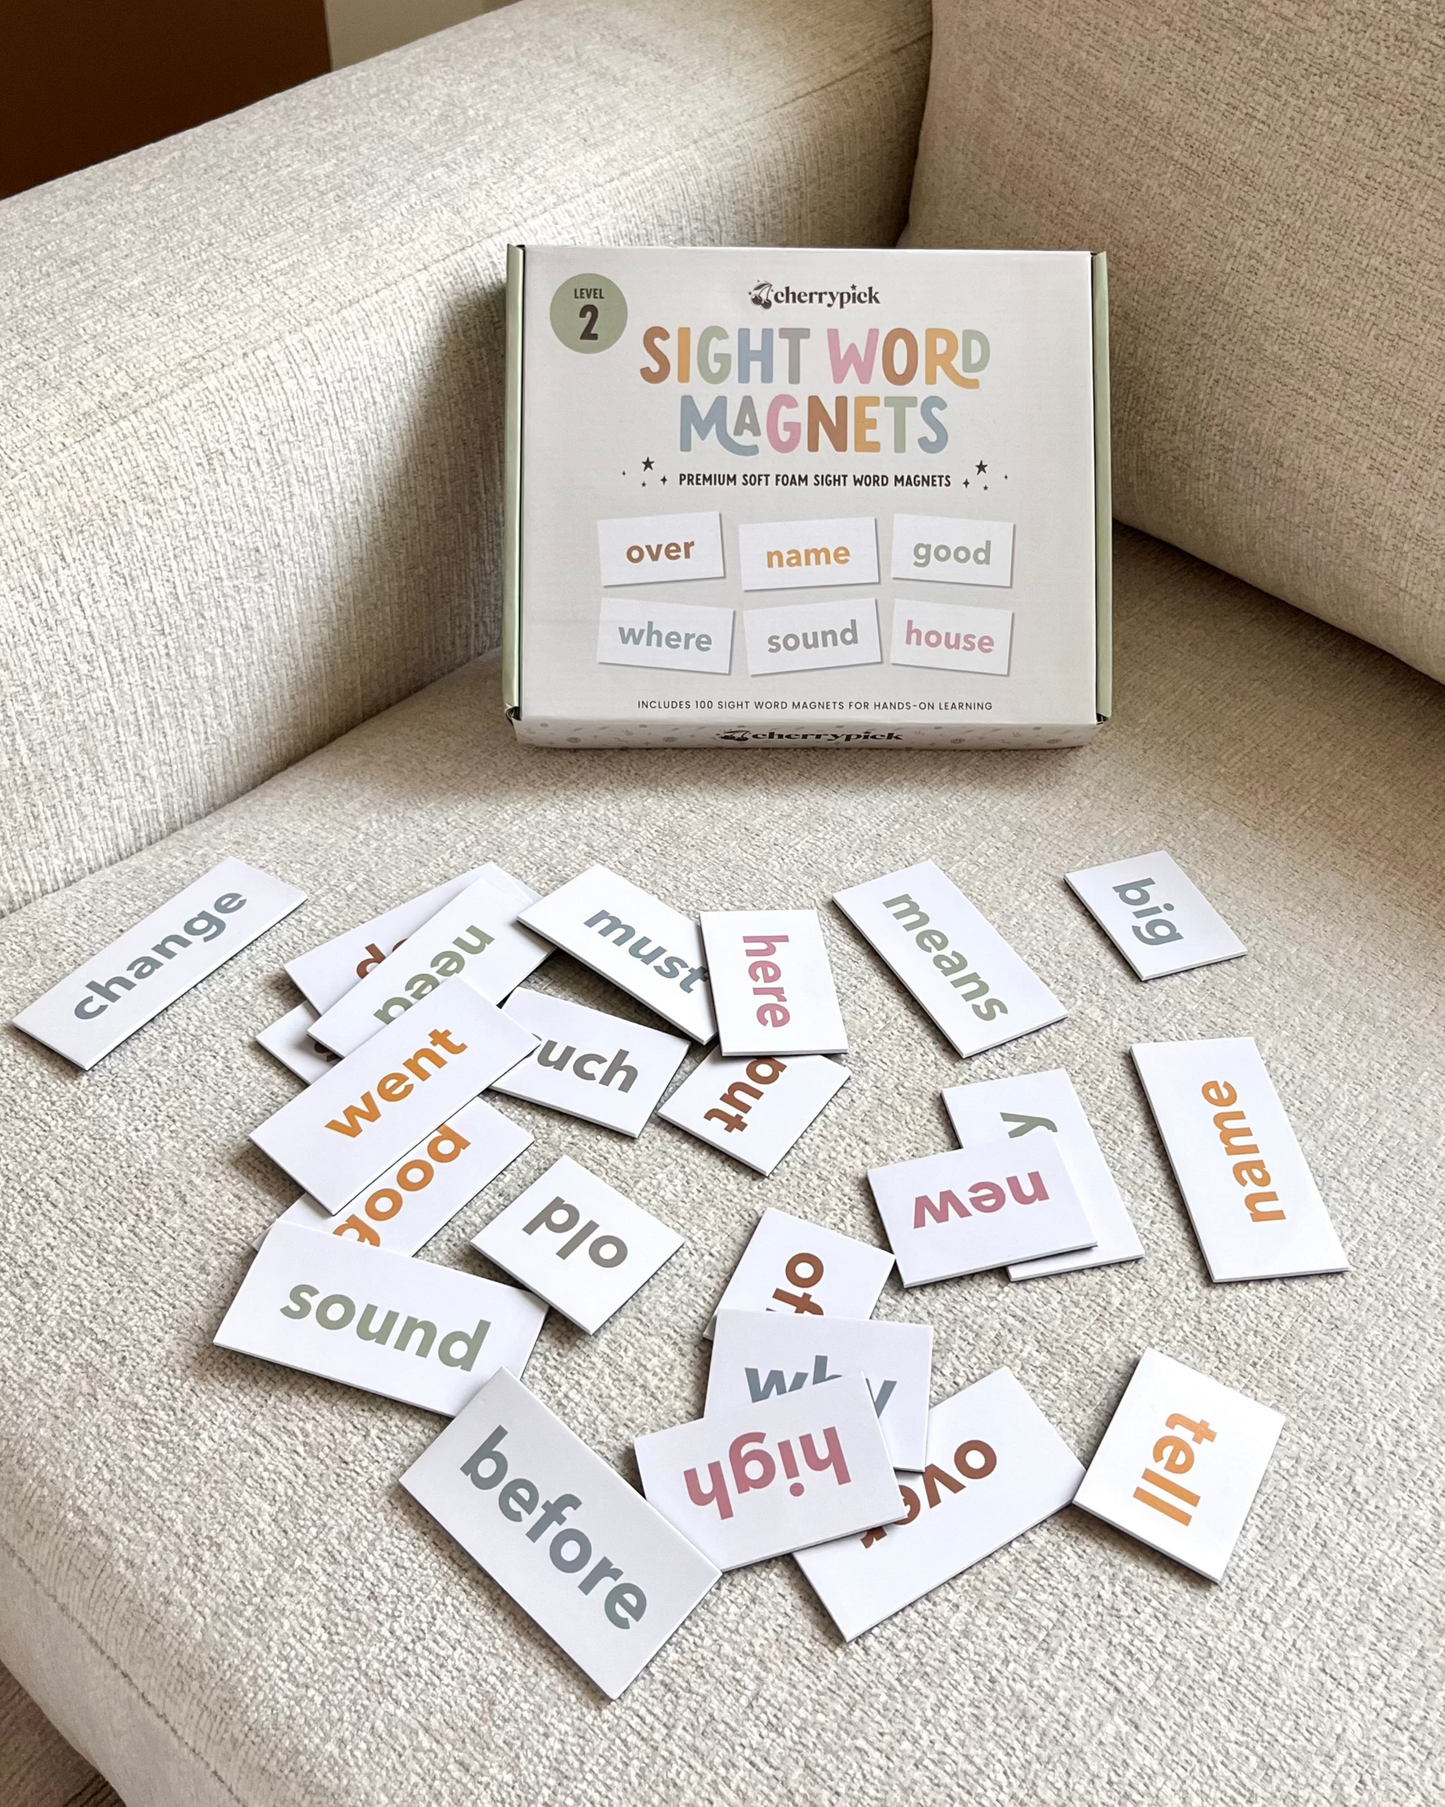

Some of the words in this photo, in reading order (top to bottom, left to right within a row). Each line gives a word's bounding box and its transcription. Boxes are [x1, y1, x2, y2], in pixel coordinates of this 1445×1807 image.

[574, 288, 604, 300] LEVEL
[579, 304, 599, 341] 2
[774, 284, 881, 309] cherrypick
[640, 326, 811, 385] SIGHT
[826, 328, 991, 390] WORD
[680, 394, 949, 457] MAGNETS
[679, 473, 737, 487] PREMIUM
[741, 473, 771, 487] SOFT
[775, 473, 809, 487] FOAM
[813, 474, 848, 488] SIGHT
[852, 474, 889, 488] WORD
[894, 475, 952, 489] MAGNETS
[625, 540, 695, 564] over
[766, 545, 851, 569] name
[913, 540, 992, 568] good
[618, 621, 713, 652] where
[767, 619, 859, 654] sound
[905, 620, 995, 654] house
[637, 700, 691, 710] INCLUDES
[694, 700, 713, 710] 100
[717, 700, 750, 710] SIGHT
[753, 700, 788, 710] WORD
[791, 701, 845, 711] MAGNETS
[848, 701, 870, 711] FOR
[873, 701, 935, 711] HANDS-ON
[938, 701, 993, 711] LEARNING
[752, 731, 903, 743] cherrypick
[1112, 878, 1184, 946] big
[74, 893, 246, 1019] change
[584, 910, 709, 994] must
[742, 935, 791, 1028] here
[883, 894, 1008, 1021] means
[324, 1029, 468, 1139] went
[531, 1034, 639, 1094] uch
[1202, 1081, 1286, 1223] name
[914, 1171, 1049, 1229] new
[522, 1196, 628, 1269] old
[766, 1253, 824, 1316] of
[280, 1283, 491, 1372] sound
[684, 1427, 852, 1520] high
[1133, 1413, 1217, 1526] tell
[460, 1425, 646, 1629] before
